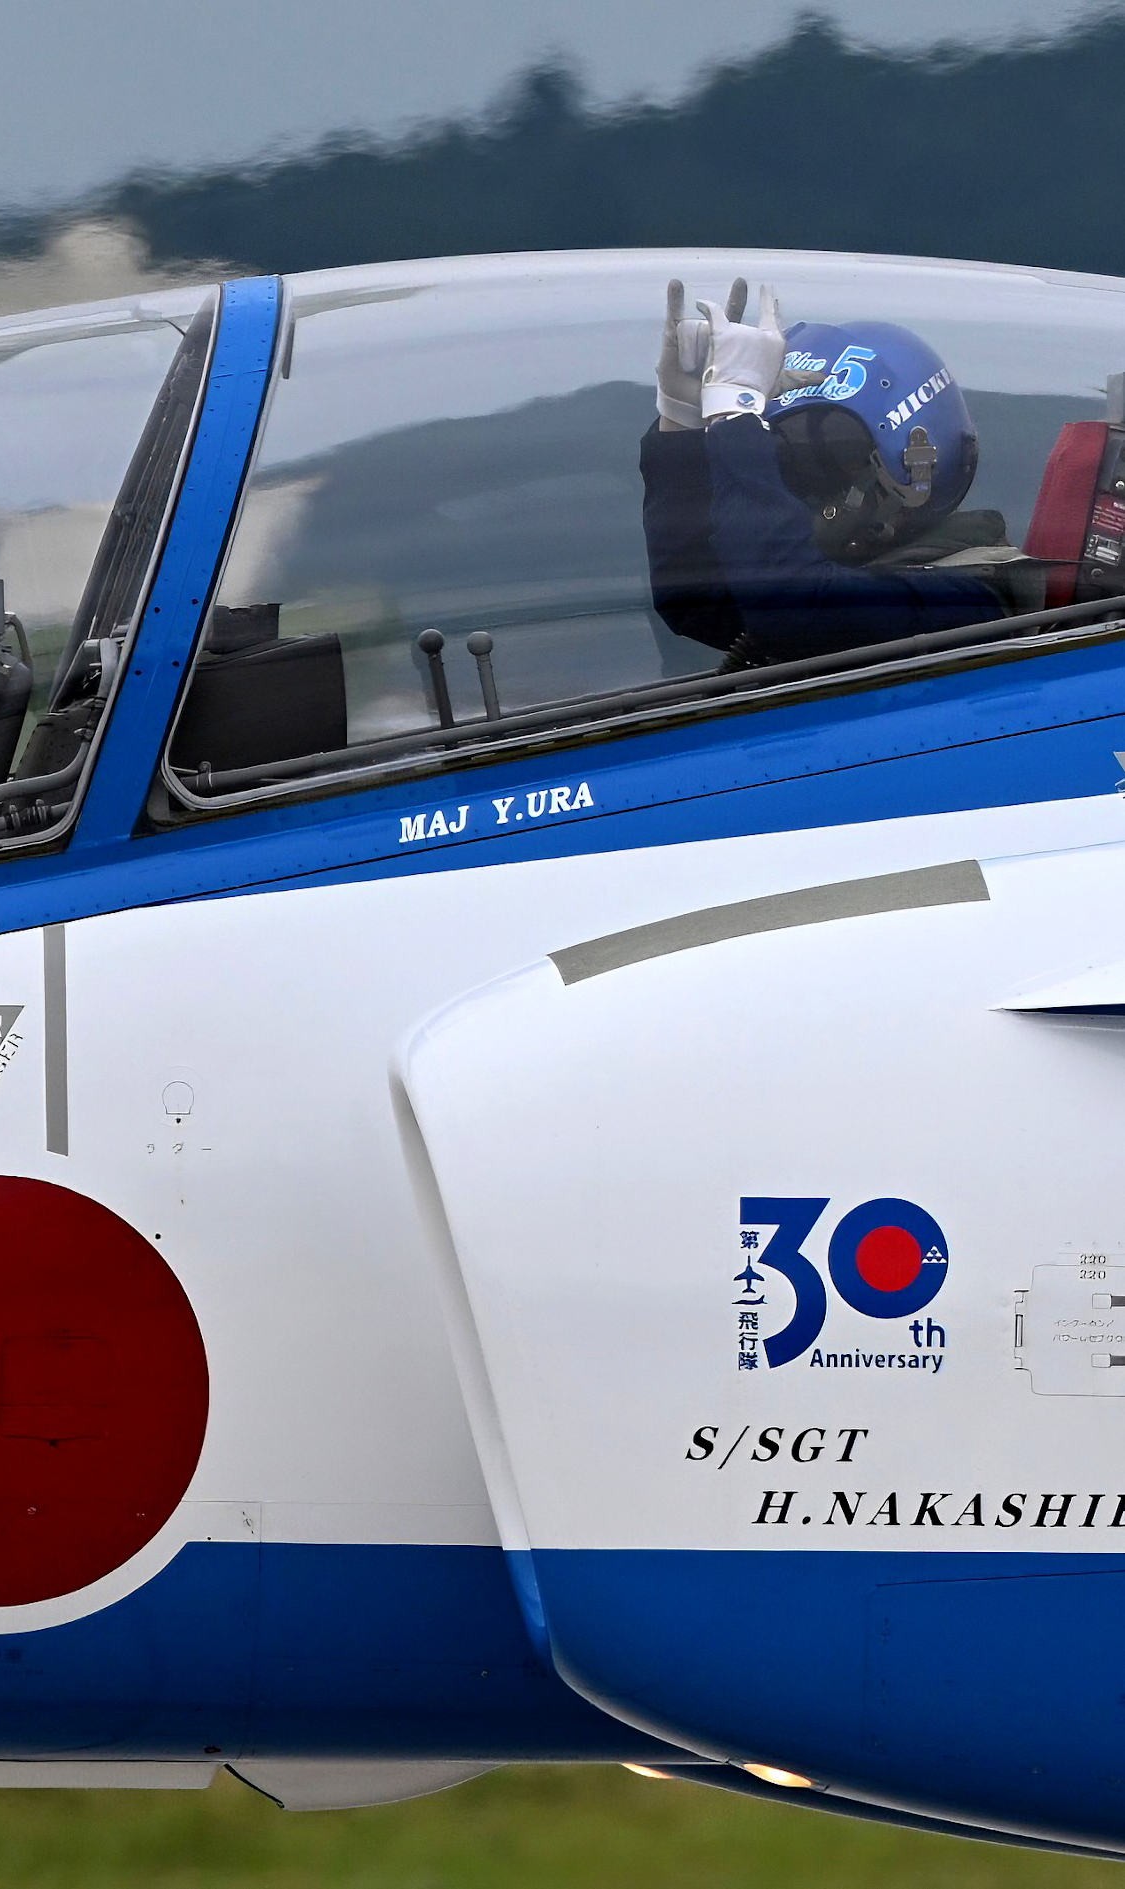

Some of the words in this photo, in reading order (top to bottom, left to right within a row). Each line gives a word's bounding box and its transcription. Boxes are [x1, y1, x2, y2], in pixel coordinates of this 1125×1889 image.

[831, 345, 877, 400] 5
[399, 805, 470, 843] MAJ
[492, 782, 595, 825] Y.URA
[1079, 1253, 1107, 1265] 220
[1079, 1269, 1107, 1280] 220
[809, 1348, 944, 1374] Anniversary
[684, 1424, 870, 1470] S/SGT
